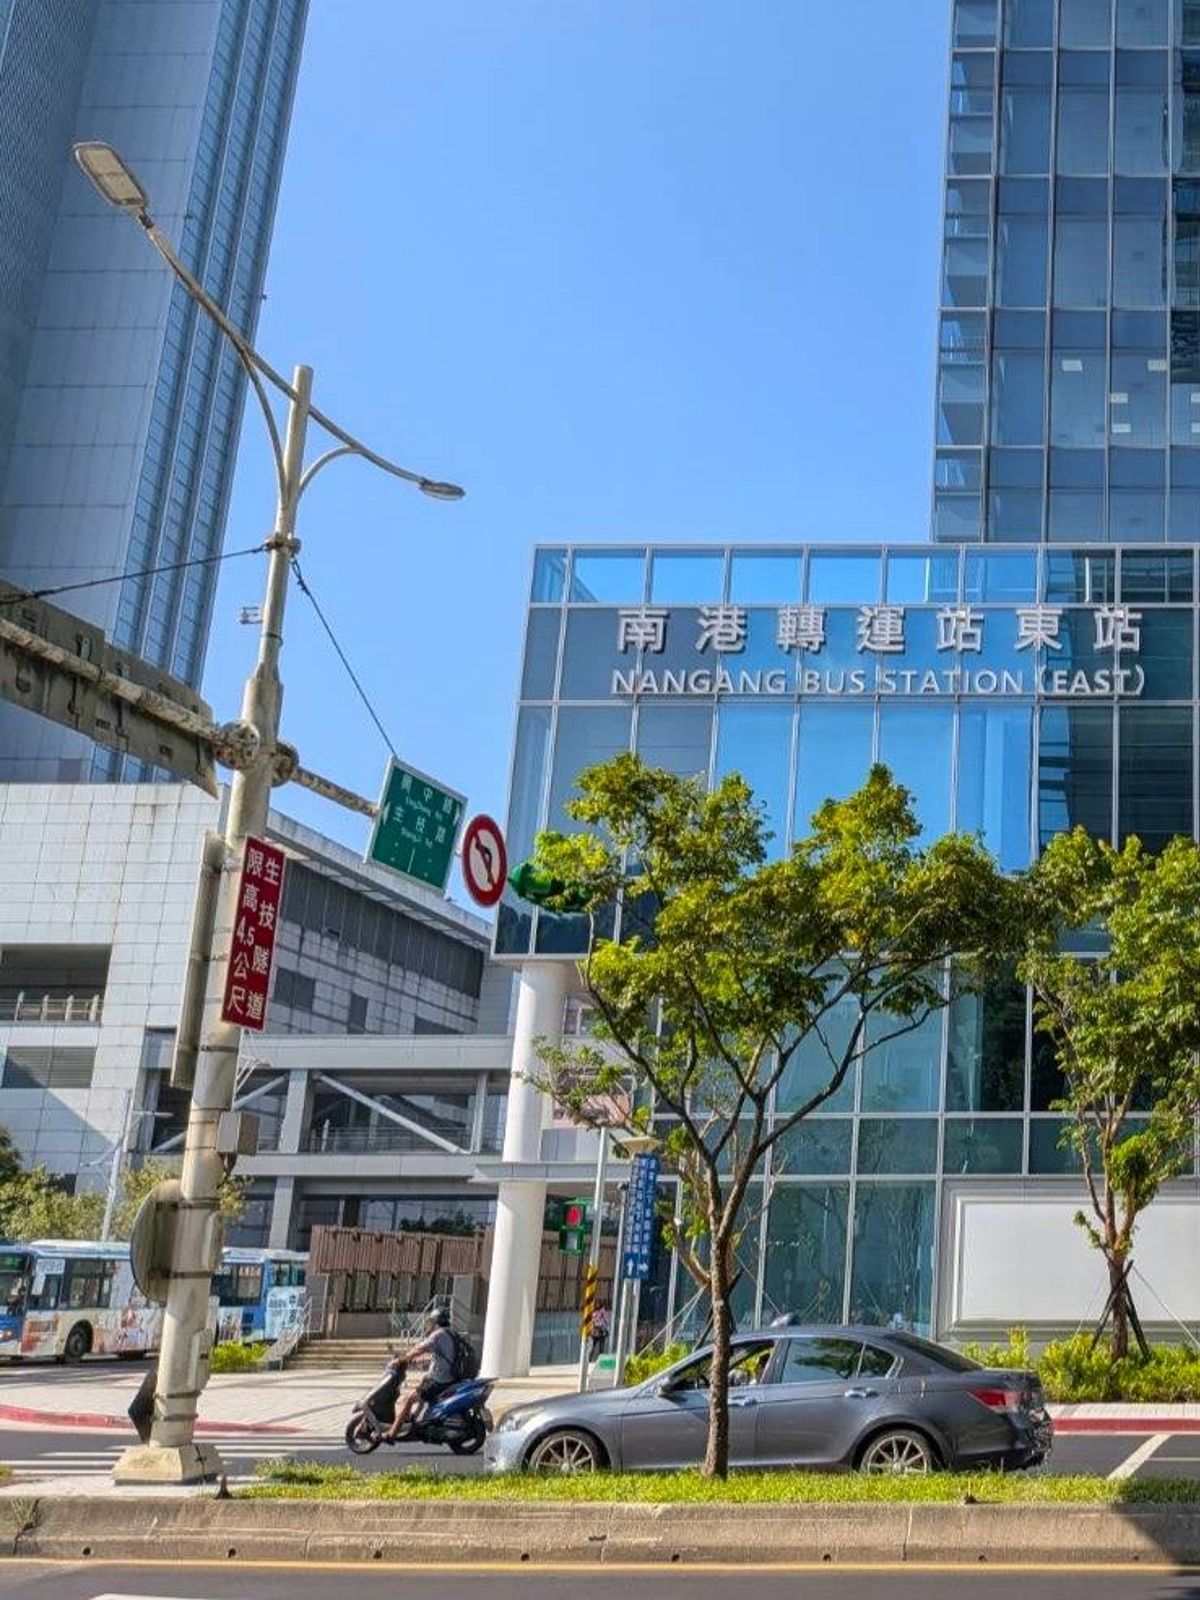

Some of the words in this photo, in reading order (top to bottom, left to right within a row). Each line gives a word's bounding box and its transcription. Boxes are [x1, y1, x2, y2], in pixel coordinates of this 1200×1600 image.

[617, 604, 1142, 653] 南港轉運站東站
[611, 669, 788, 694] NANGANG
[803, 669, 866, 694] BUS
[882, 669, 1024, 694] STATION
[1038, 664, 1146, 696] (EAST)
[245, 856, 281, 1021] 生技隧道
